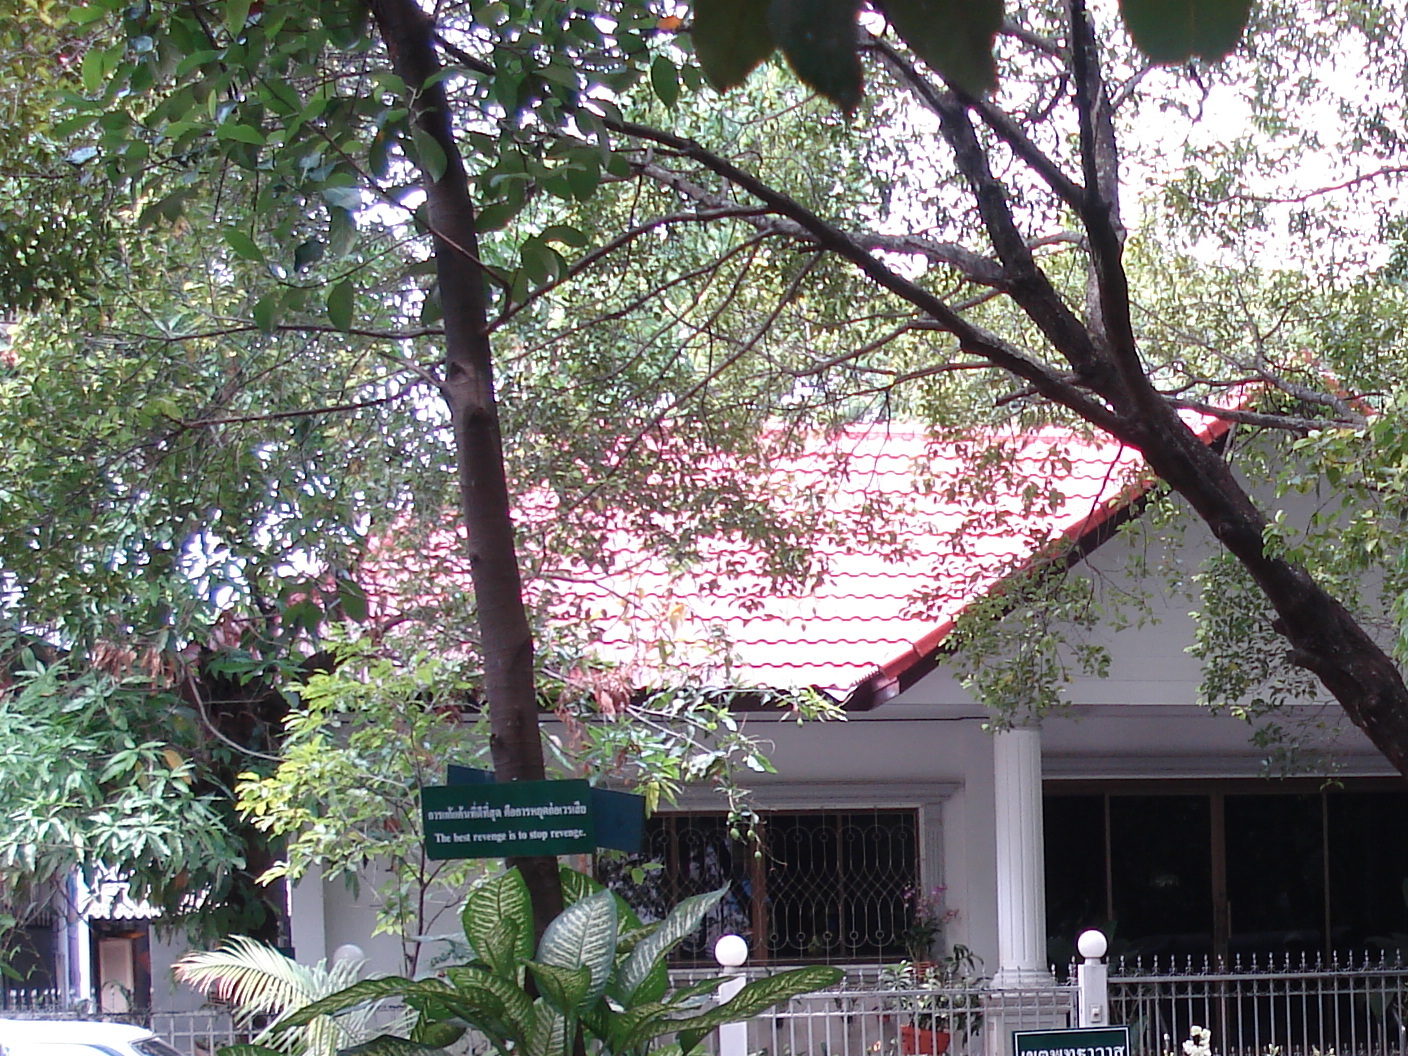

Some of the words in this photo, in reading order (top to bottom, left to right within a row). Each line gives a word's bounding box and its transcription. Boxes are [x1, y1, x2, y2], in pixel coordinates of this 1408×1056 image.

[434, 833, 450, 843] The
[453, 832, 470, 843] best
[473, 833, 506, 843] revenge
[508, 830, 516, 840] is
[518, 831, 527, 840] to
[529, 830, 548, 841] stop
[550, 829, 586, 839] revenge.
